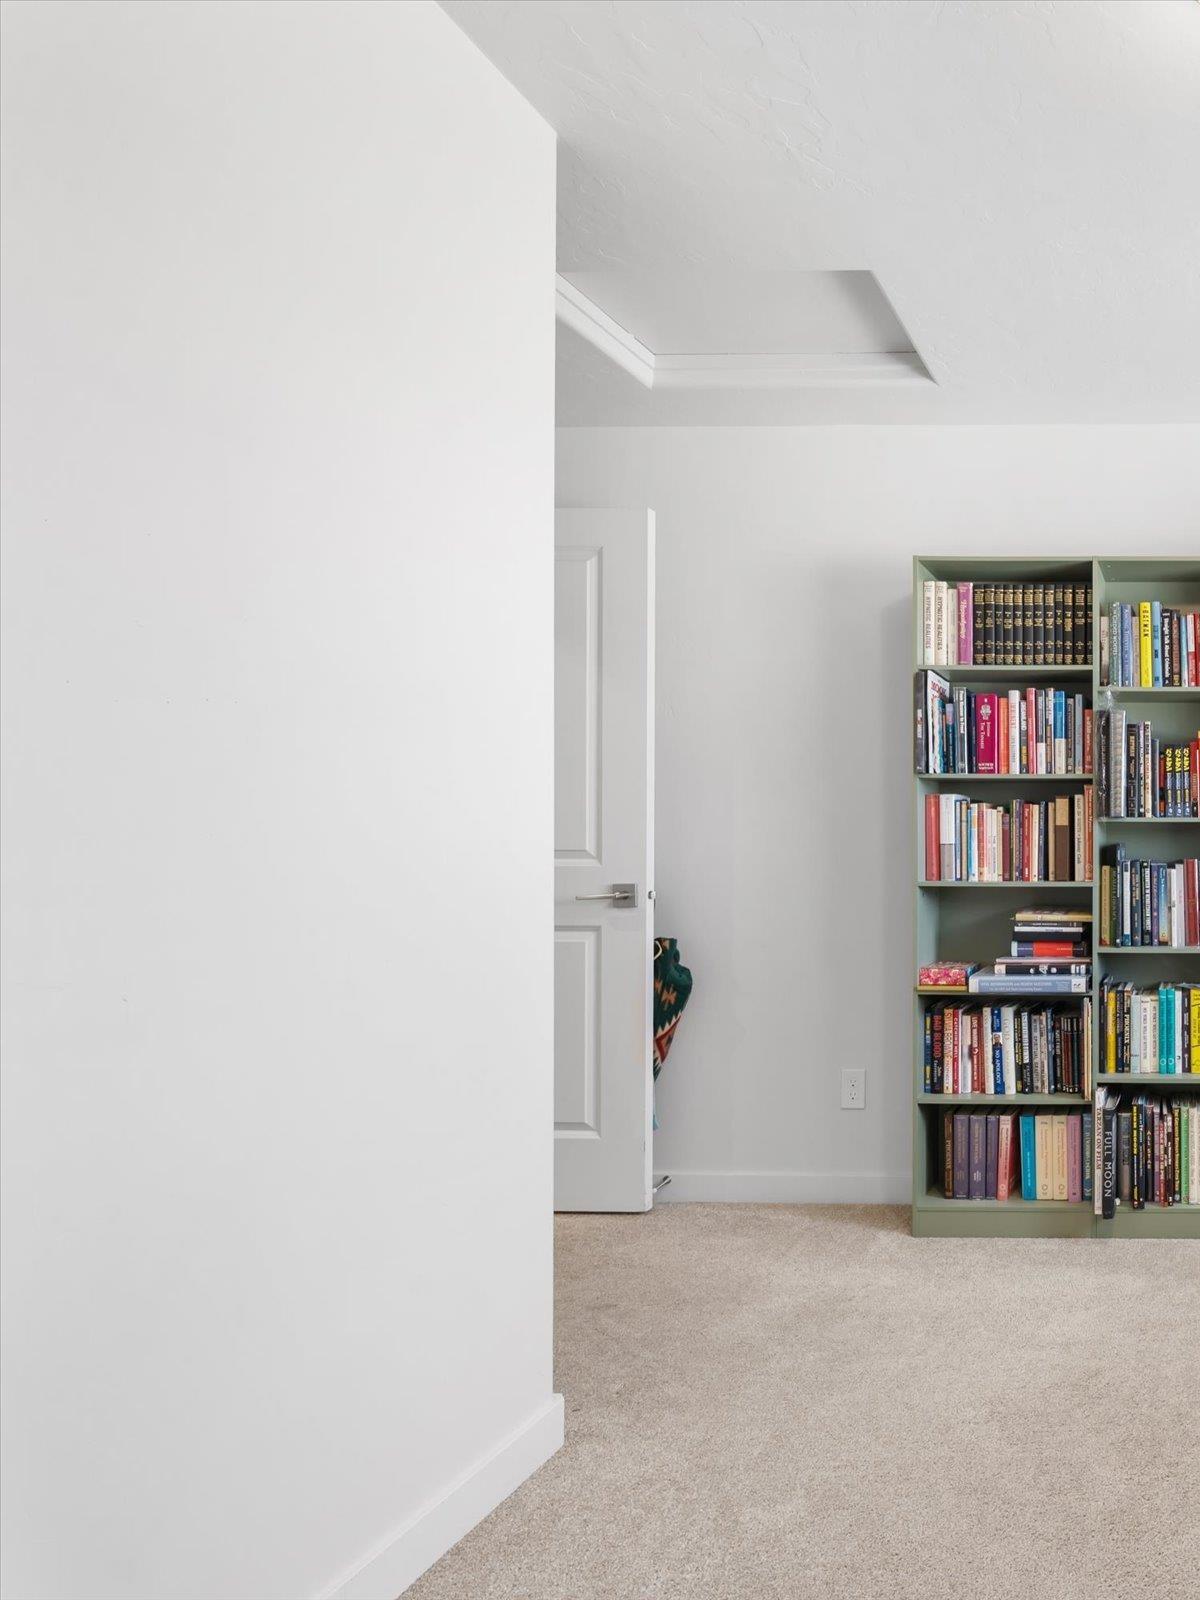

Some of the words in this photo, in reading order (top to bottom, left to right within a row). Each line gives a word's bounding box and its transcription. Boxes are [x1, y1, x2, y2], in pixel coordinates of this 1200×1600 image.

[933, 1015, 942, 1031] BAD
[933, 1032, 942, 1058] BLOOD
[945, 1139, 953, 1170] PHOENIX
[1096, 1138, 1102, 1150] ON
[1104, 1130, 1113, 1157] FULL
[1104, 1161, 1113, 1198] MOON
